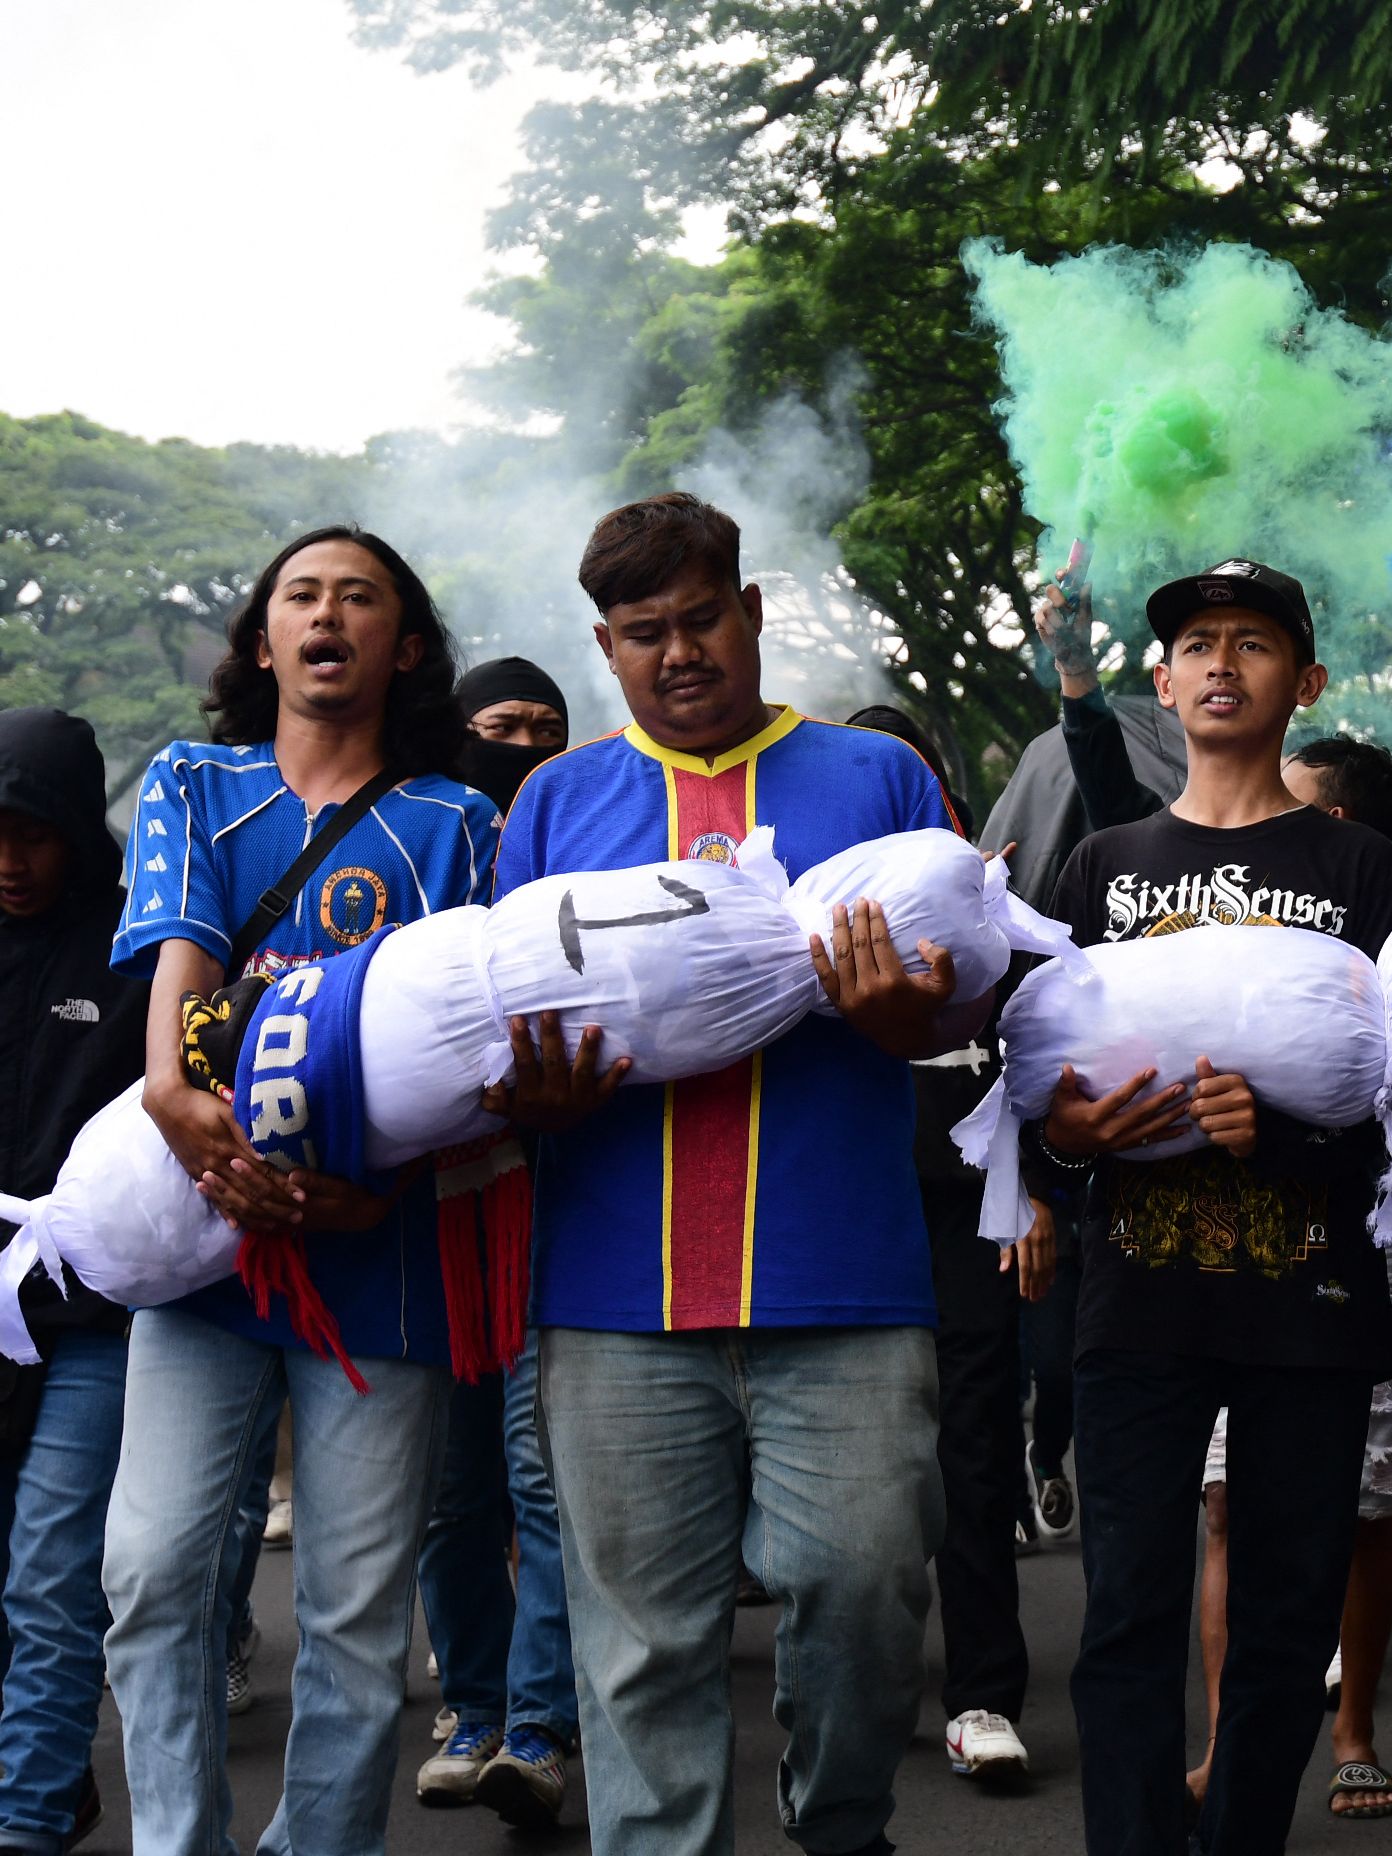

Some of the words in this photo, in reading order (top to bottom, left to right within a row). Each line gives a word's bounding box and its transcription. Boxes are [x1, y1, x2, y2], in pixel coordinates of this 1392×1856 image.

[699, 834, 730, 848] AREMA
[51, 1004, 84, 1014] NORTH
[59, 1011, 83, 1021] FACE
